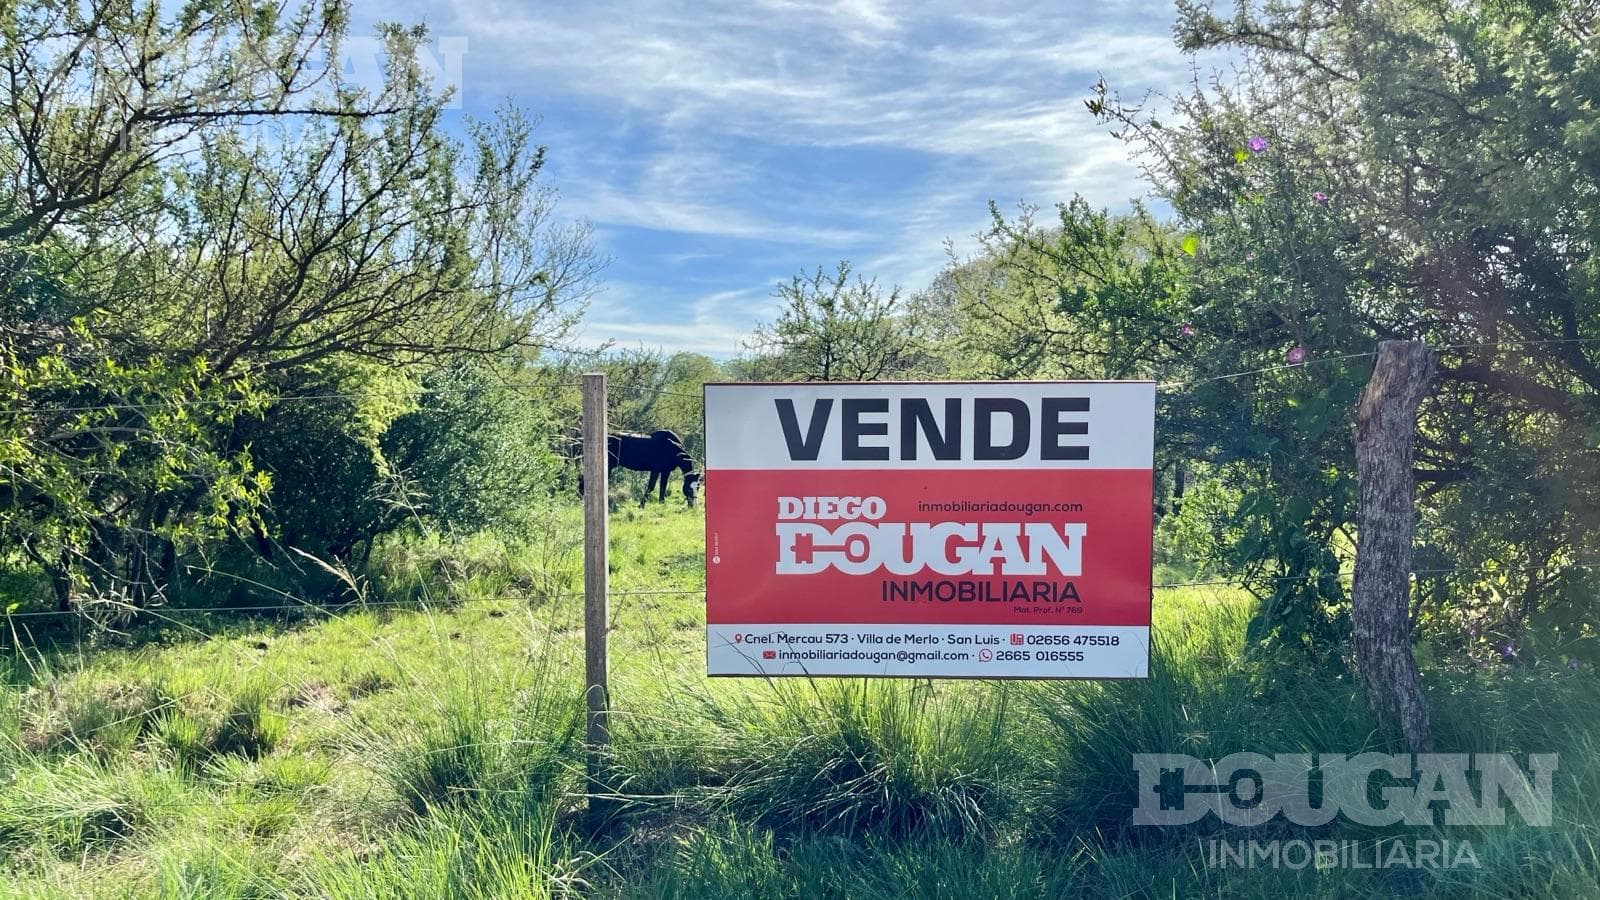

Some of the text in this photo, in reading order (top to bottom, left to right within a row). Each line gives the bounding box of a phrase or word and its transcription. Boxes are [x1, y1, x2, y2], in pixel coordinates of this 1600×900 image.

[775, 397, 1091, 461] VENDE
[777, 496, 887, 520] DIEGO
[918, 500, 1083, 516] inmobiliariadougan.com
[775, 521, 1088, 577] DOUGAN
[882, 580, 1081, 603] INMOBILIARIA
[744, 633, 1000, 645] Cnel. Mercau 573 Villa de Merlo San Luis
[1027, 635, 1120, 647] 02656 475518
[778, 649, 969, 663] inmobiliariadougan@gmail.com
[996, 651, 1084, 662] 2665 016555
